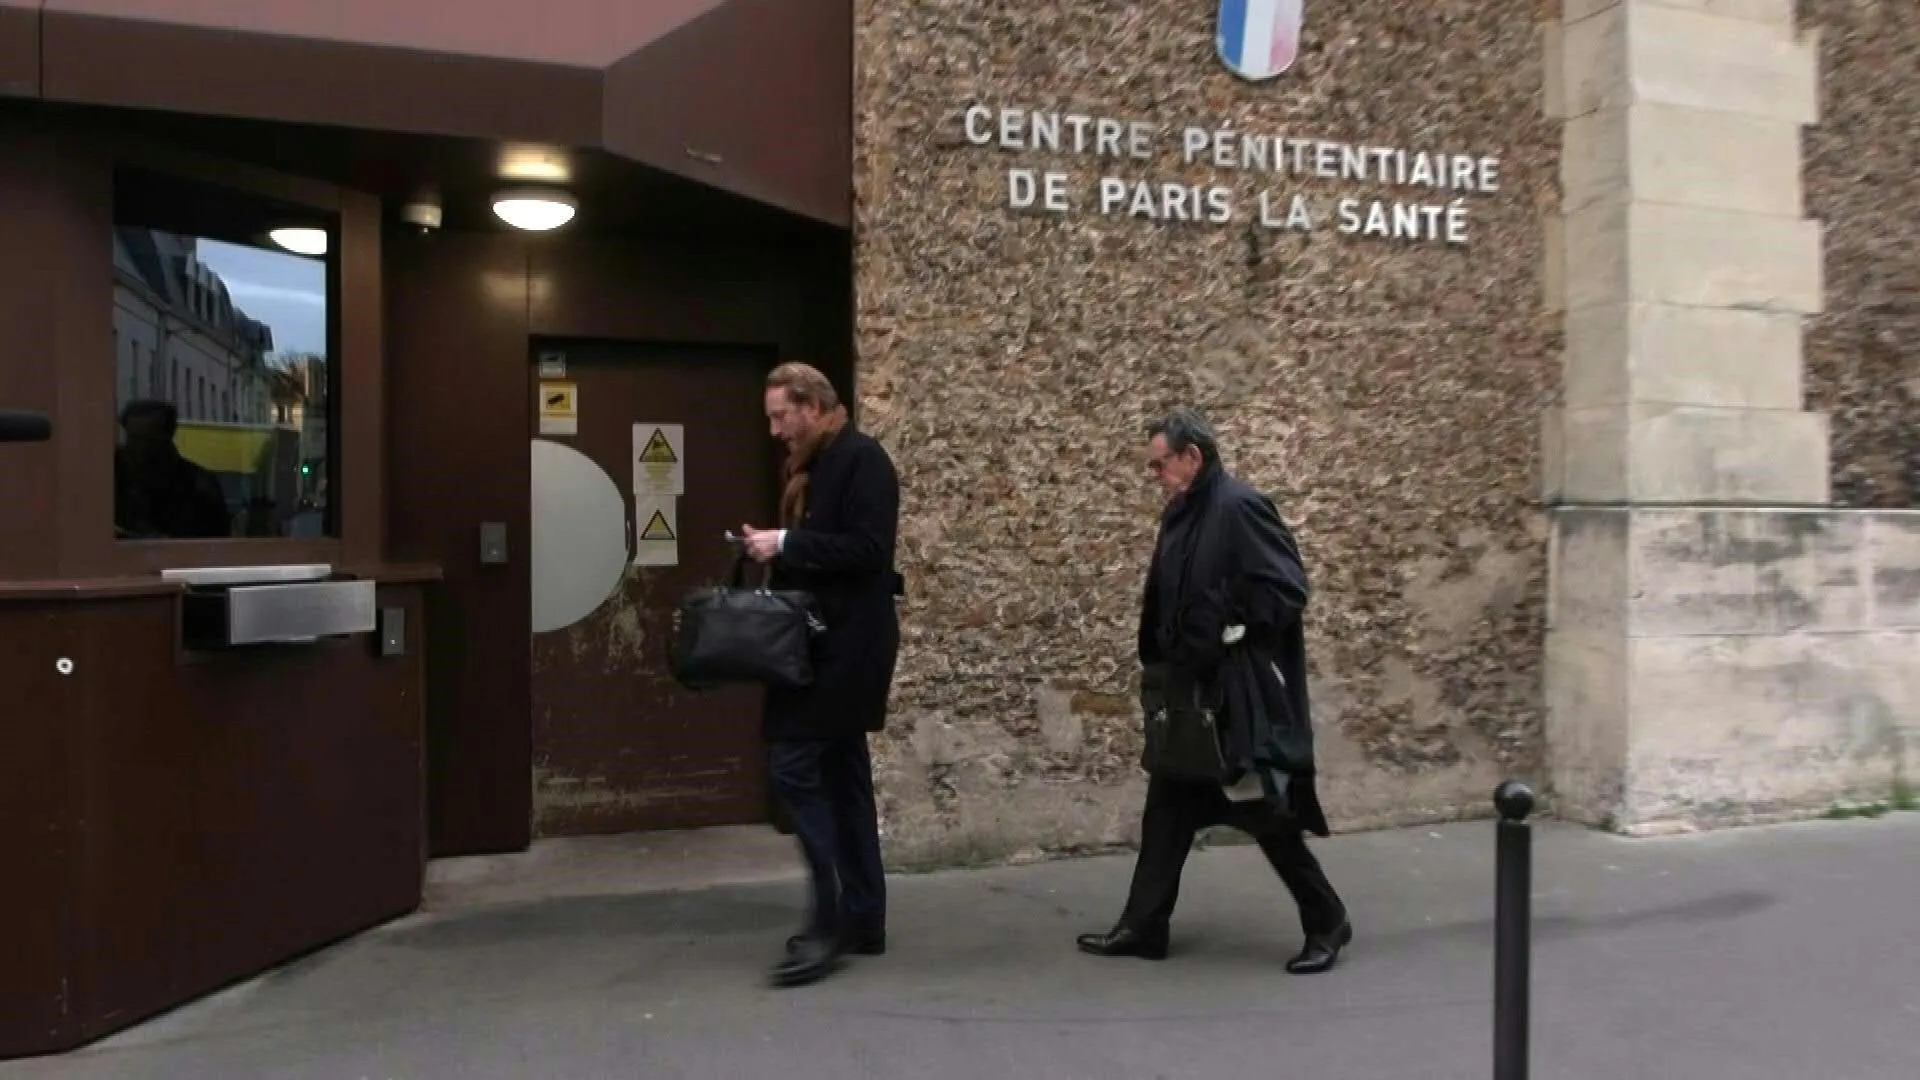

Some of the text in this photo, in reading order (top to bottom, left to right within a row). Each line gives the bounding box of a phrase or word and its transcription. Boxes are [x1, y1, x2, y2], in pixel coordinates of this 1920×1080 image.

[965, 104, 1500, 192] CENTRE PÉNITENTIAIRE
[1008, 170, 1468, 243] DE PARIS LA SANTÉ
